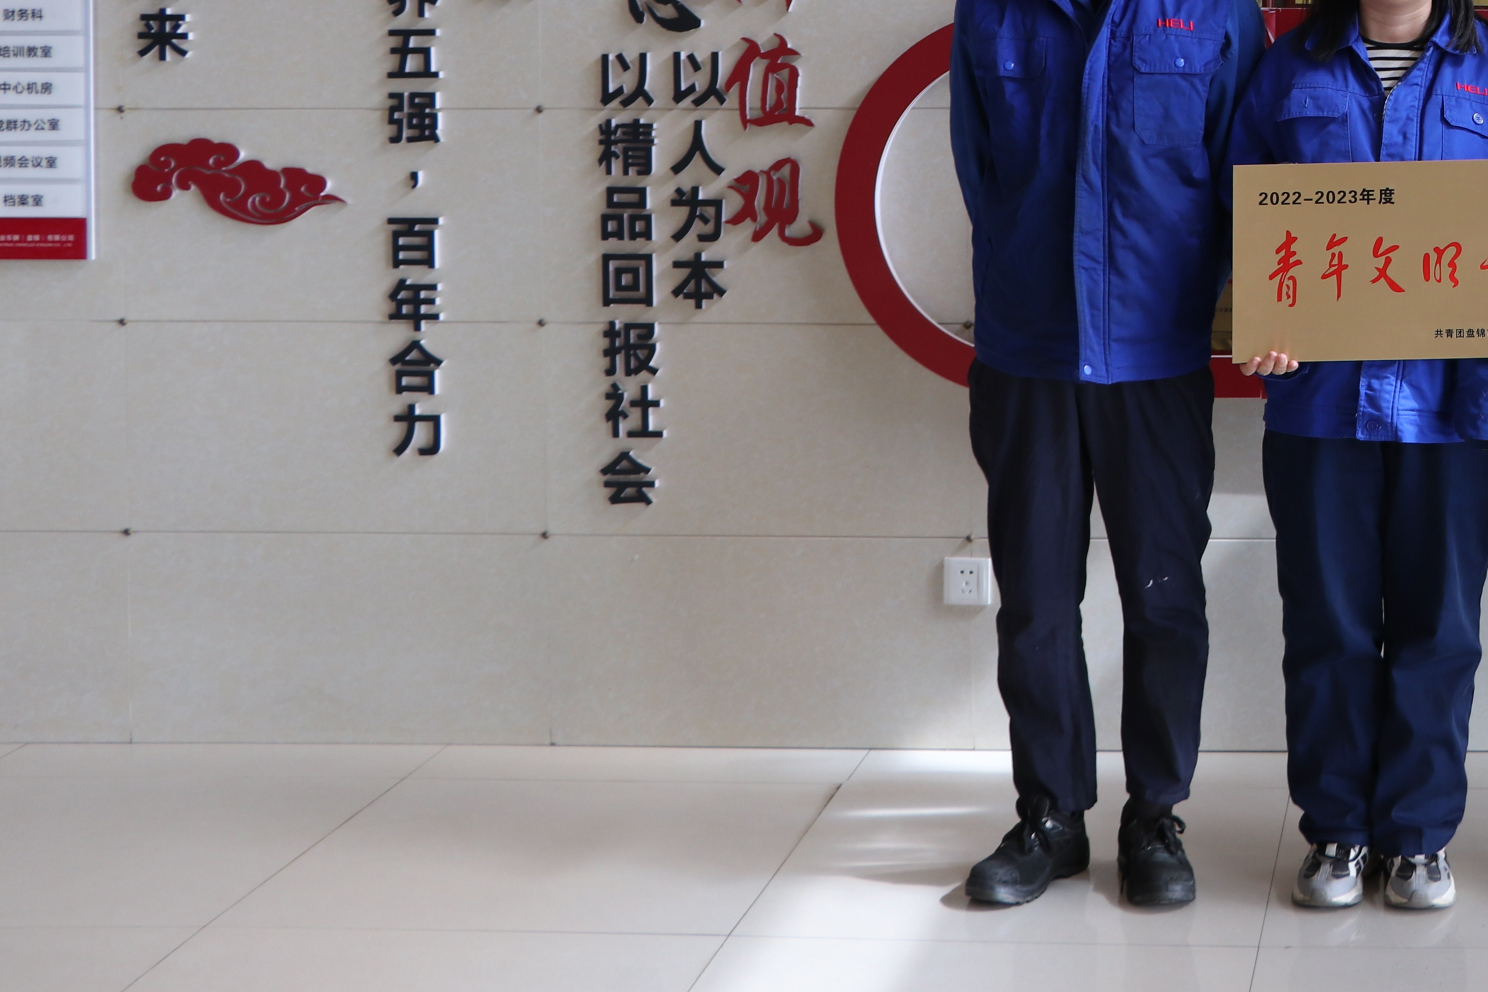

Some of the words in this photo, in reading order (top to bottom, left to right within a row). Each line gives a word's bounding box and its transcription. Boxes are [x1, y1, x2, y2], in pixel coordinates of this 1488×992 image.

[3, 8, 44, 22] 财务科
[1157, 17, 1195, 31] HELI
[0, 45, 52, 58] 培训教室
[0, 81, 53, 95] 中心机房
[1455, 82, 1488, 96] HELI
[669, 51, 728, 312] 以人为本
[3, 194, 44, 207] 档案室
[598, 51, 665, 507] 以精品回报社会
